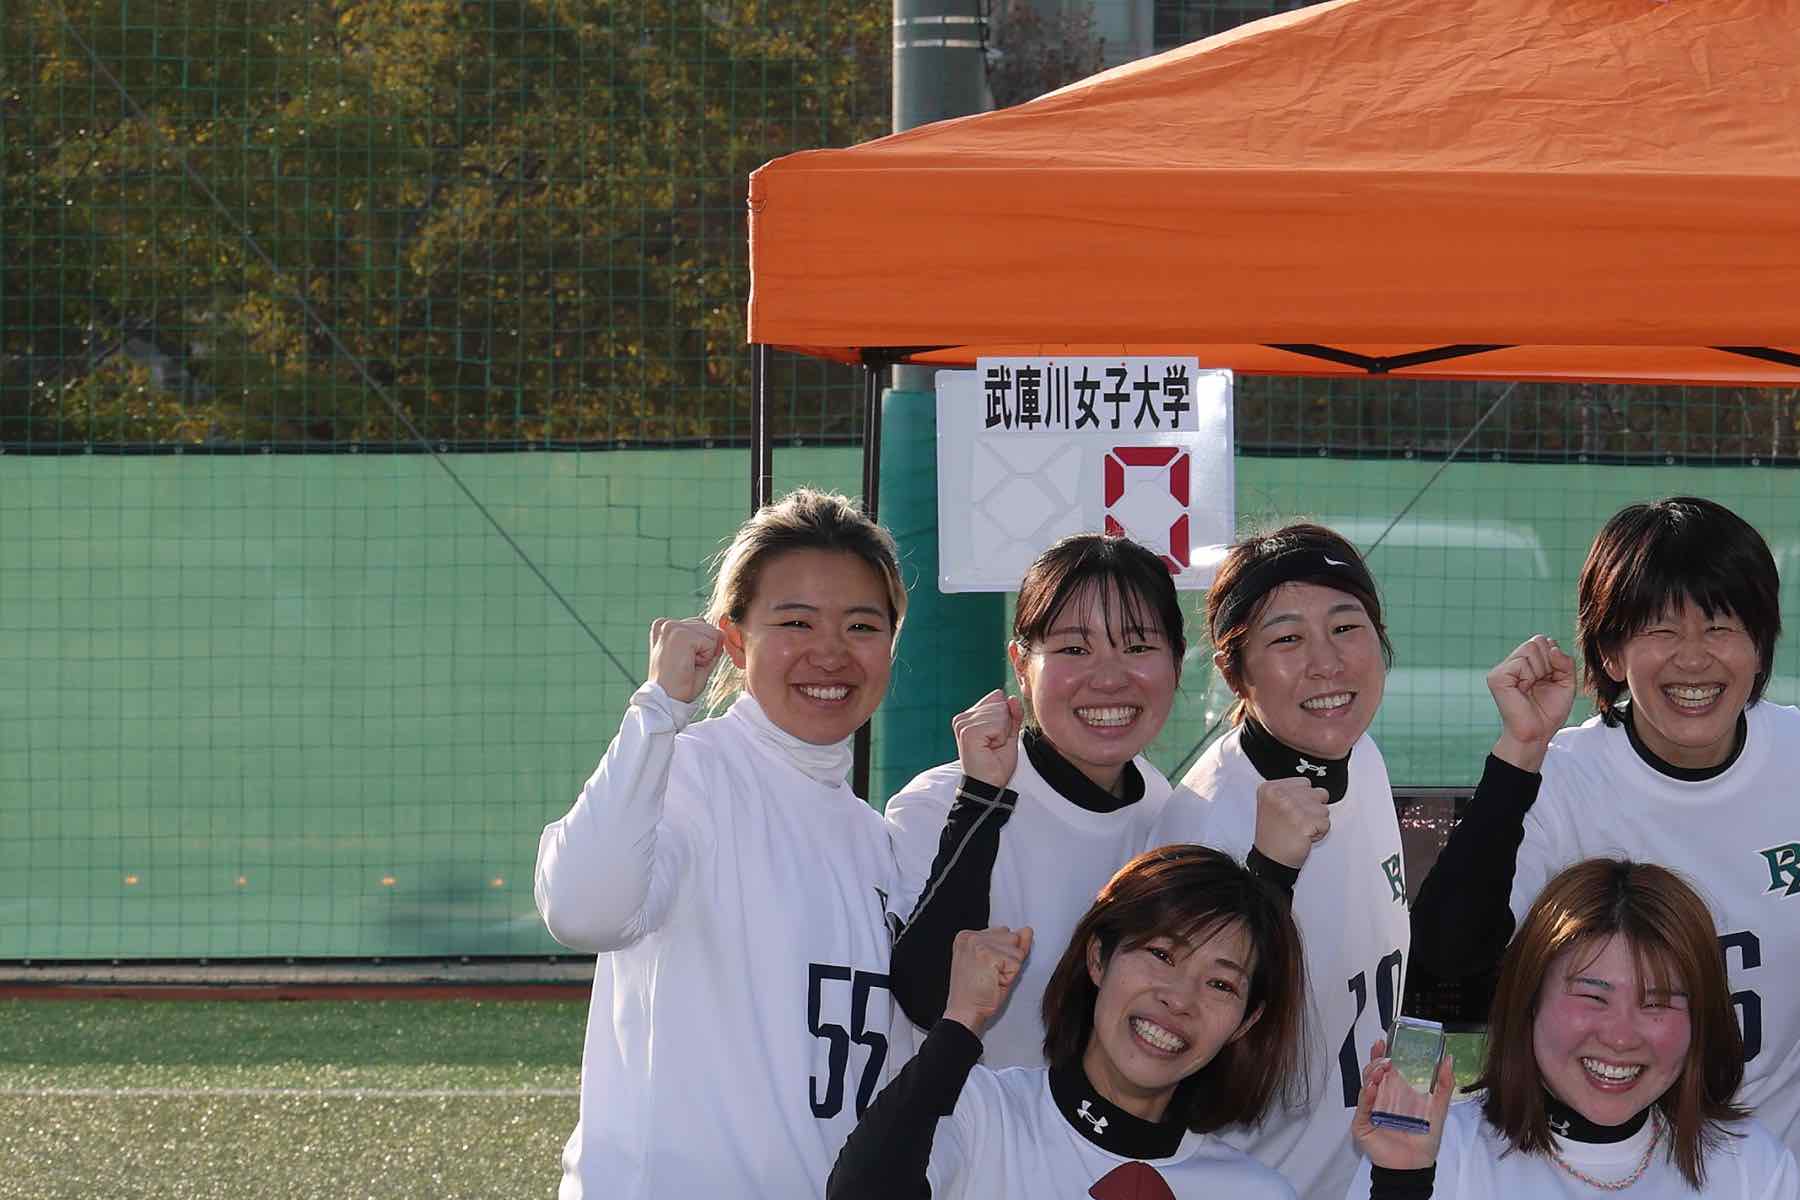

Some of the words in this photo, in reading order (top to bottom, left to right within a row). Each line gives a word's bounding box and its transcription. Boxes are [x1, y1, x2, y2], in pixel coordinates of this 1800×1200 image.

[984, 364, 1190, 430] 武庫川女子大学
[1104, 446, 1190, 575] 0
[807, 962, 893, 1122] 55
